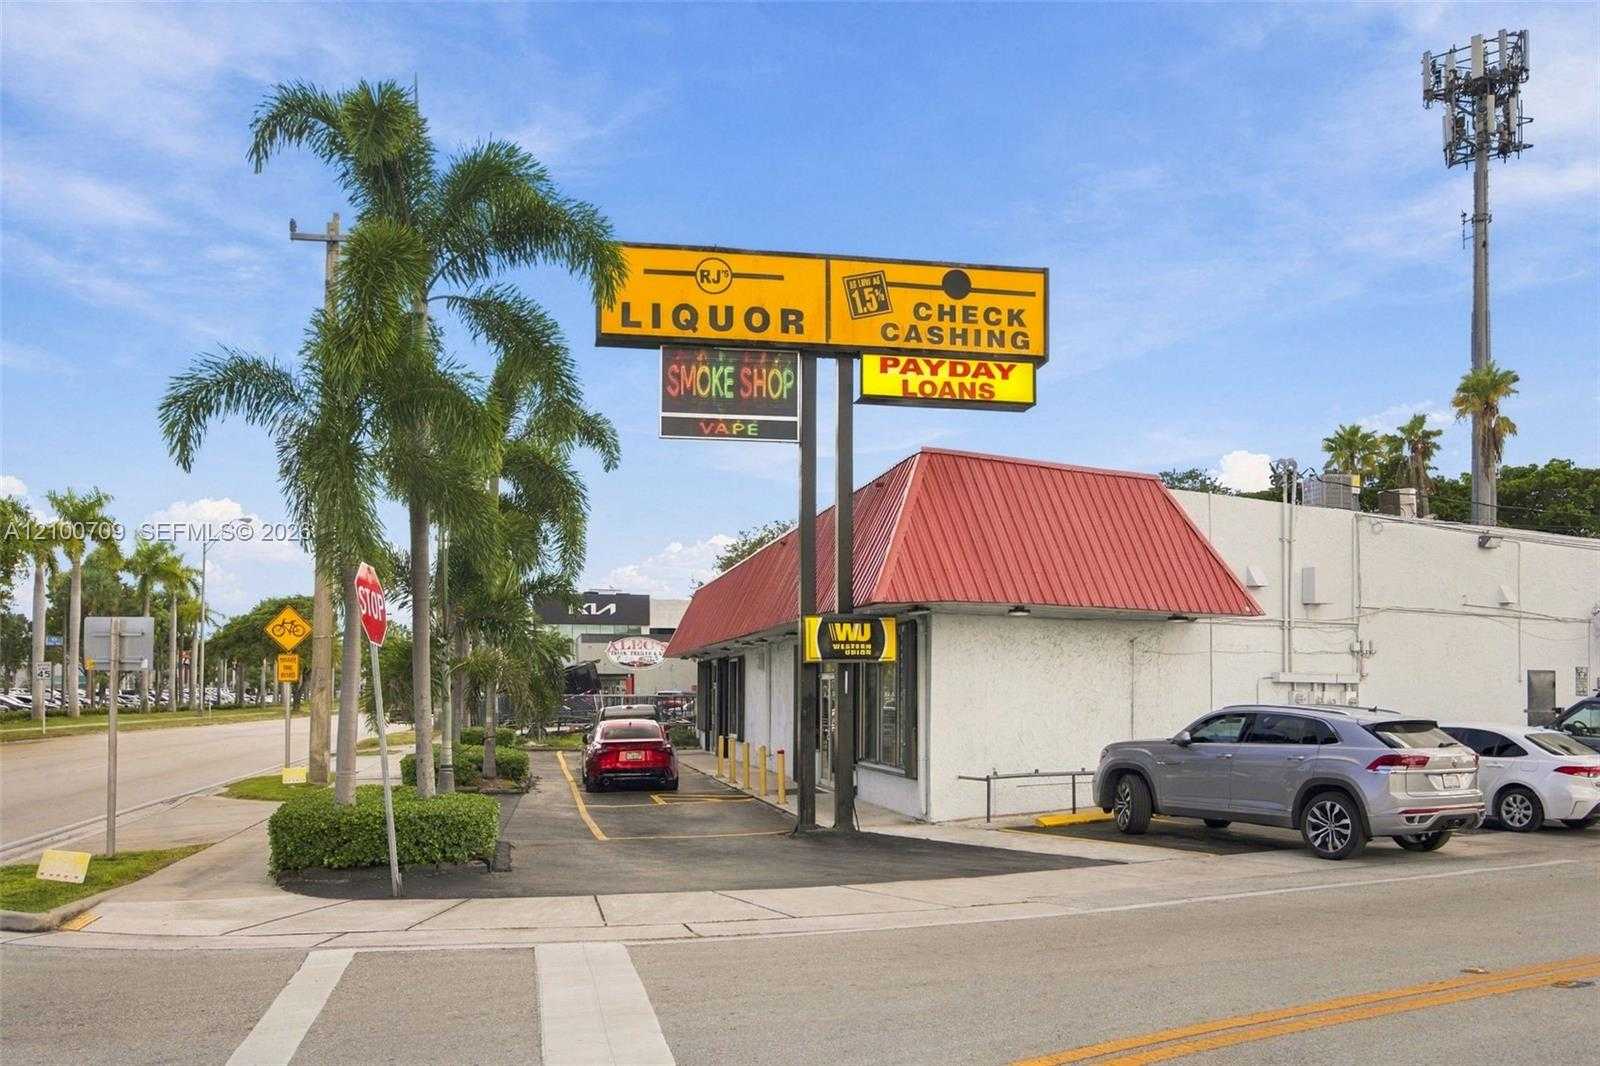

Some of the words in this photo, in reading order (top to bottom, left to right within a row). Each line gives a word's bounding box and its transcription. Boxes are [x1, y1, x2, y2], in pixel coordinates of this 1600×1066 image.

[621, 302, 804, 335] LIQUOR
[913, 302, 1026, 328] CHECK
[880, 322, 1030, 350] CASHING
[880, 356, 1017, 380] PAYDAY
[666, 364, 735, 399] SMOKE
[740, 367, 795, 399] SHOP
[902, 379, 996, 399] LOANS
[699, 421, 759, 436] VAPE
[358, 585, 385, 621] STOP
[832, 643, 872, 651] WESTERN
[37, 670, 51, 678] 45
